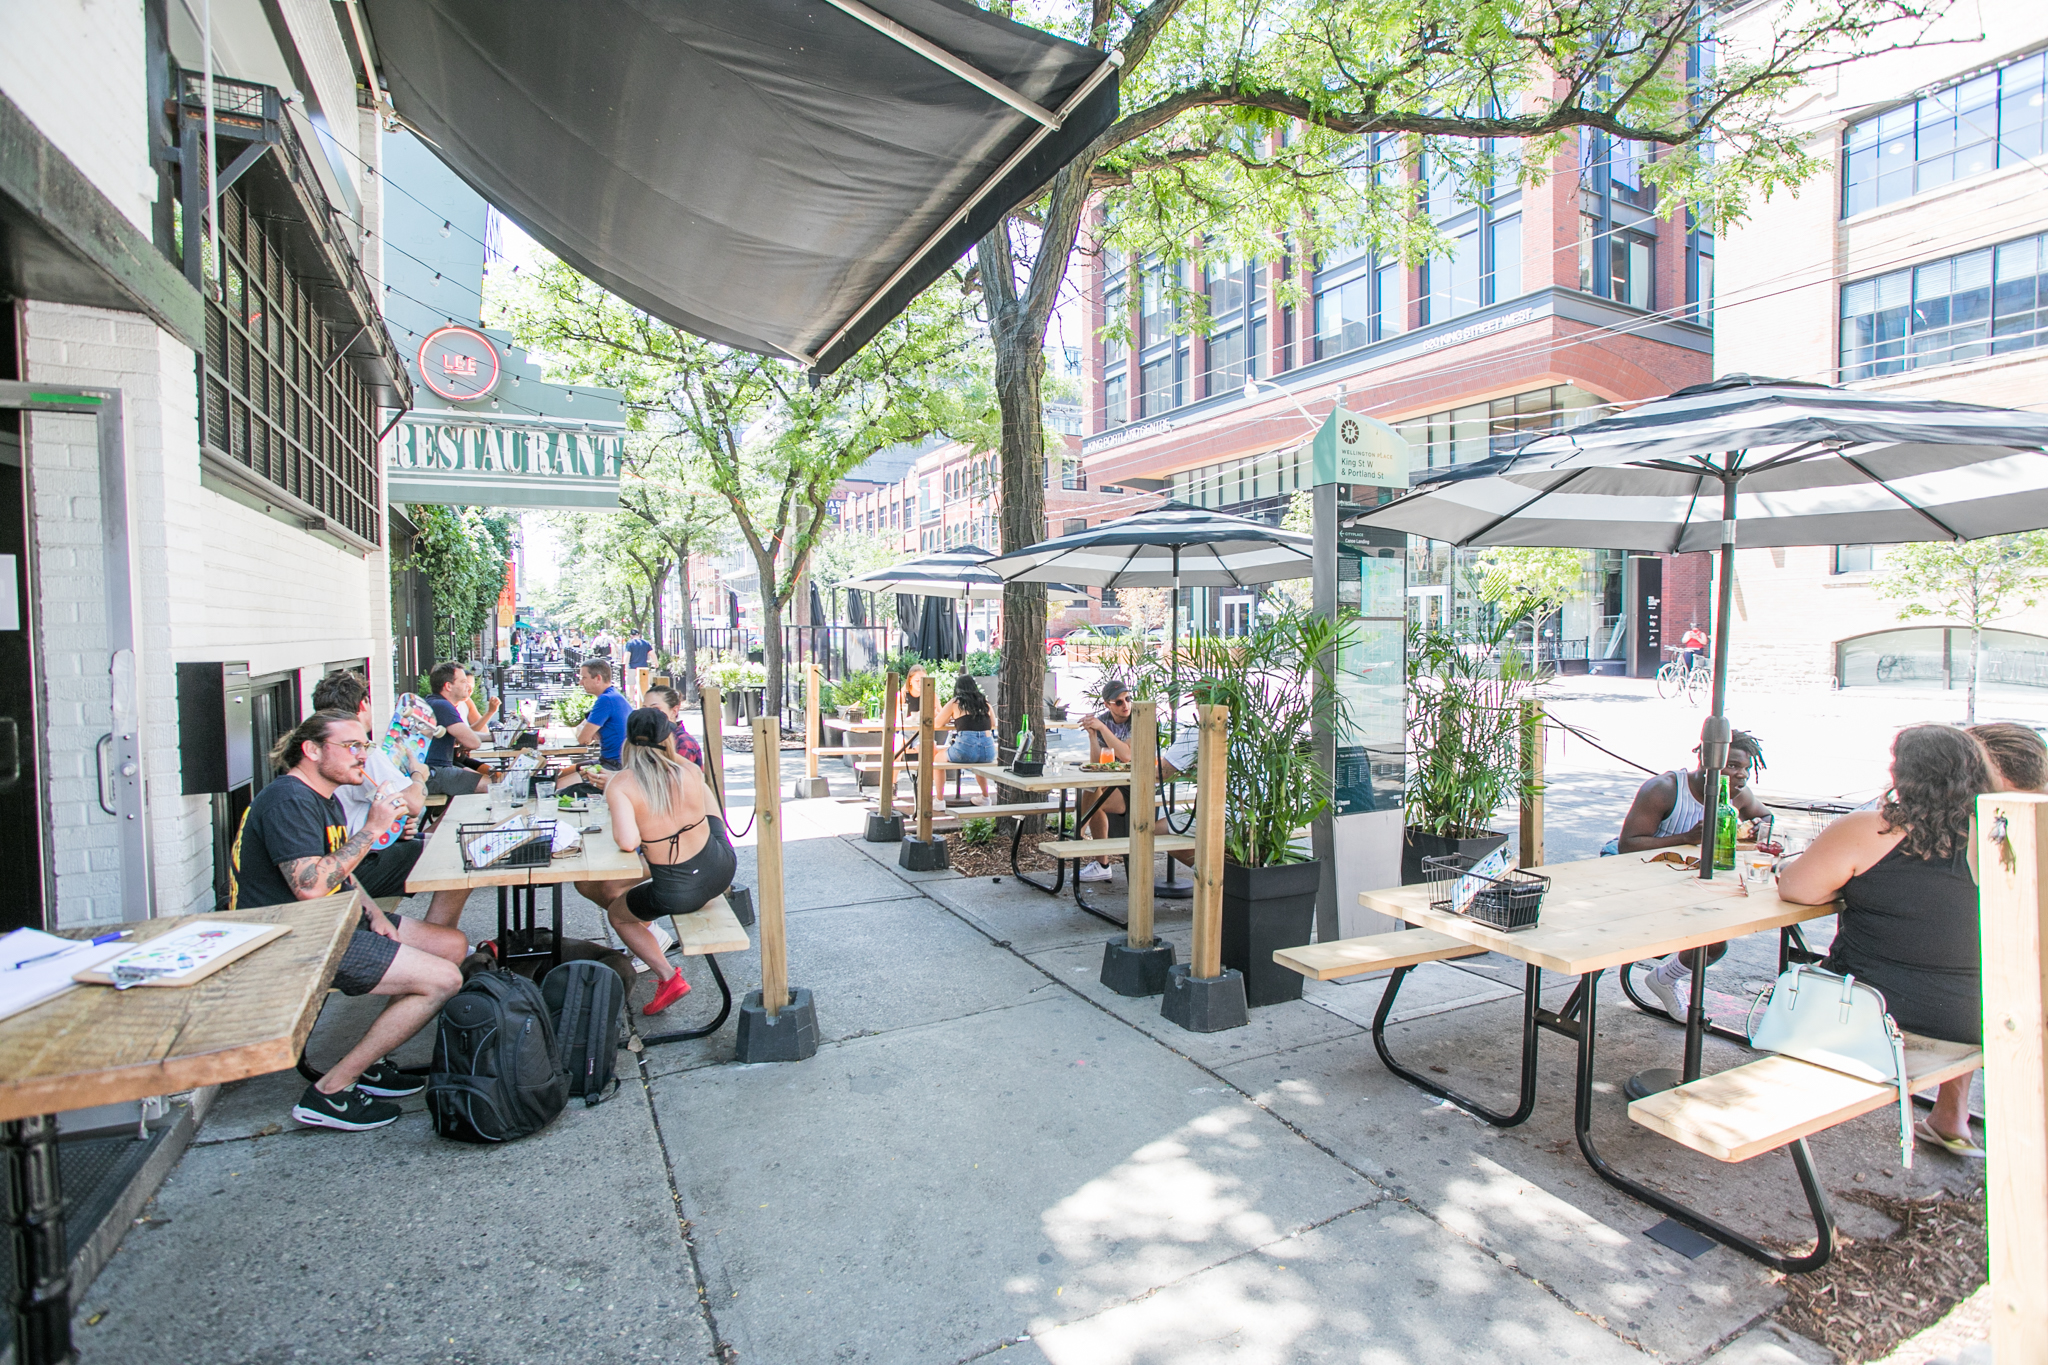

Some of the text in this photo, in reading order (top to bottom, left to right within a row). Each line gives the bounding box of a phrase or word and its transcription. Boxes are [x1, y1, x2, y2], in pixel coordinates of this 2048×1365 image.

[1439, 330, 1463, 345] KING
[1463, 318, 1501, 338] STREET
[1501, 307, 1533, 326] WEST
[1088, 418, 1170, 451] KING PORTLAND CENTRE
[388, 424, 621, 477] RESTAURANT
[1342, 449, 1393, 460] WELLINGTON PLACE
[1341, 468, 1384, 480] & Portland St
[1342, 458, 1374, 468] King St W
